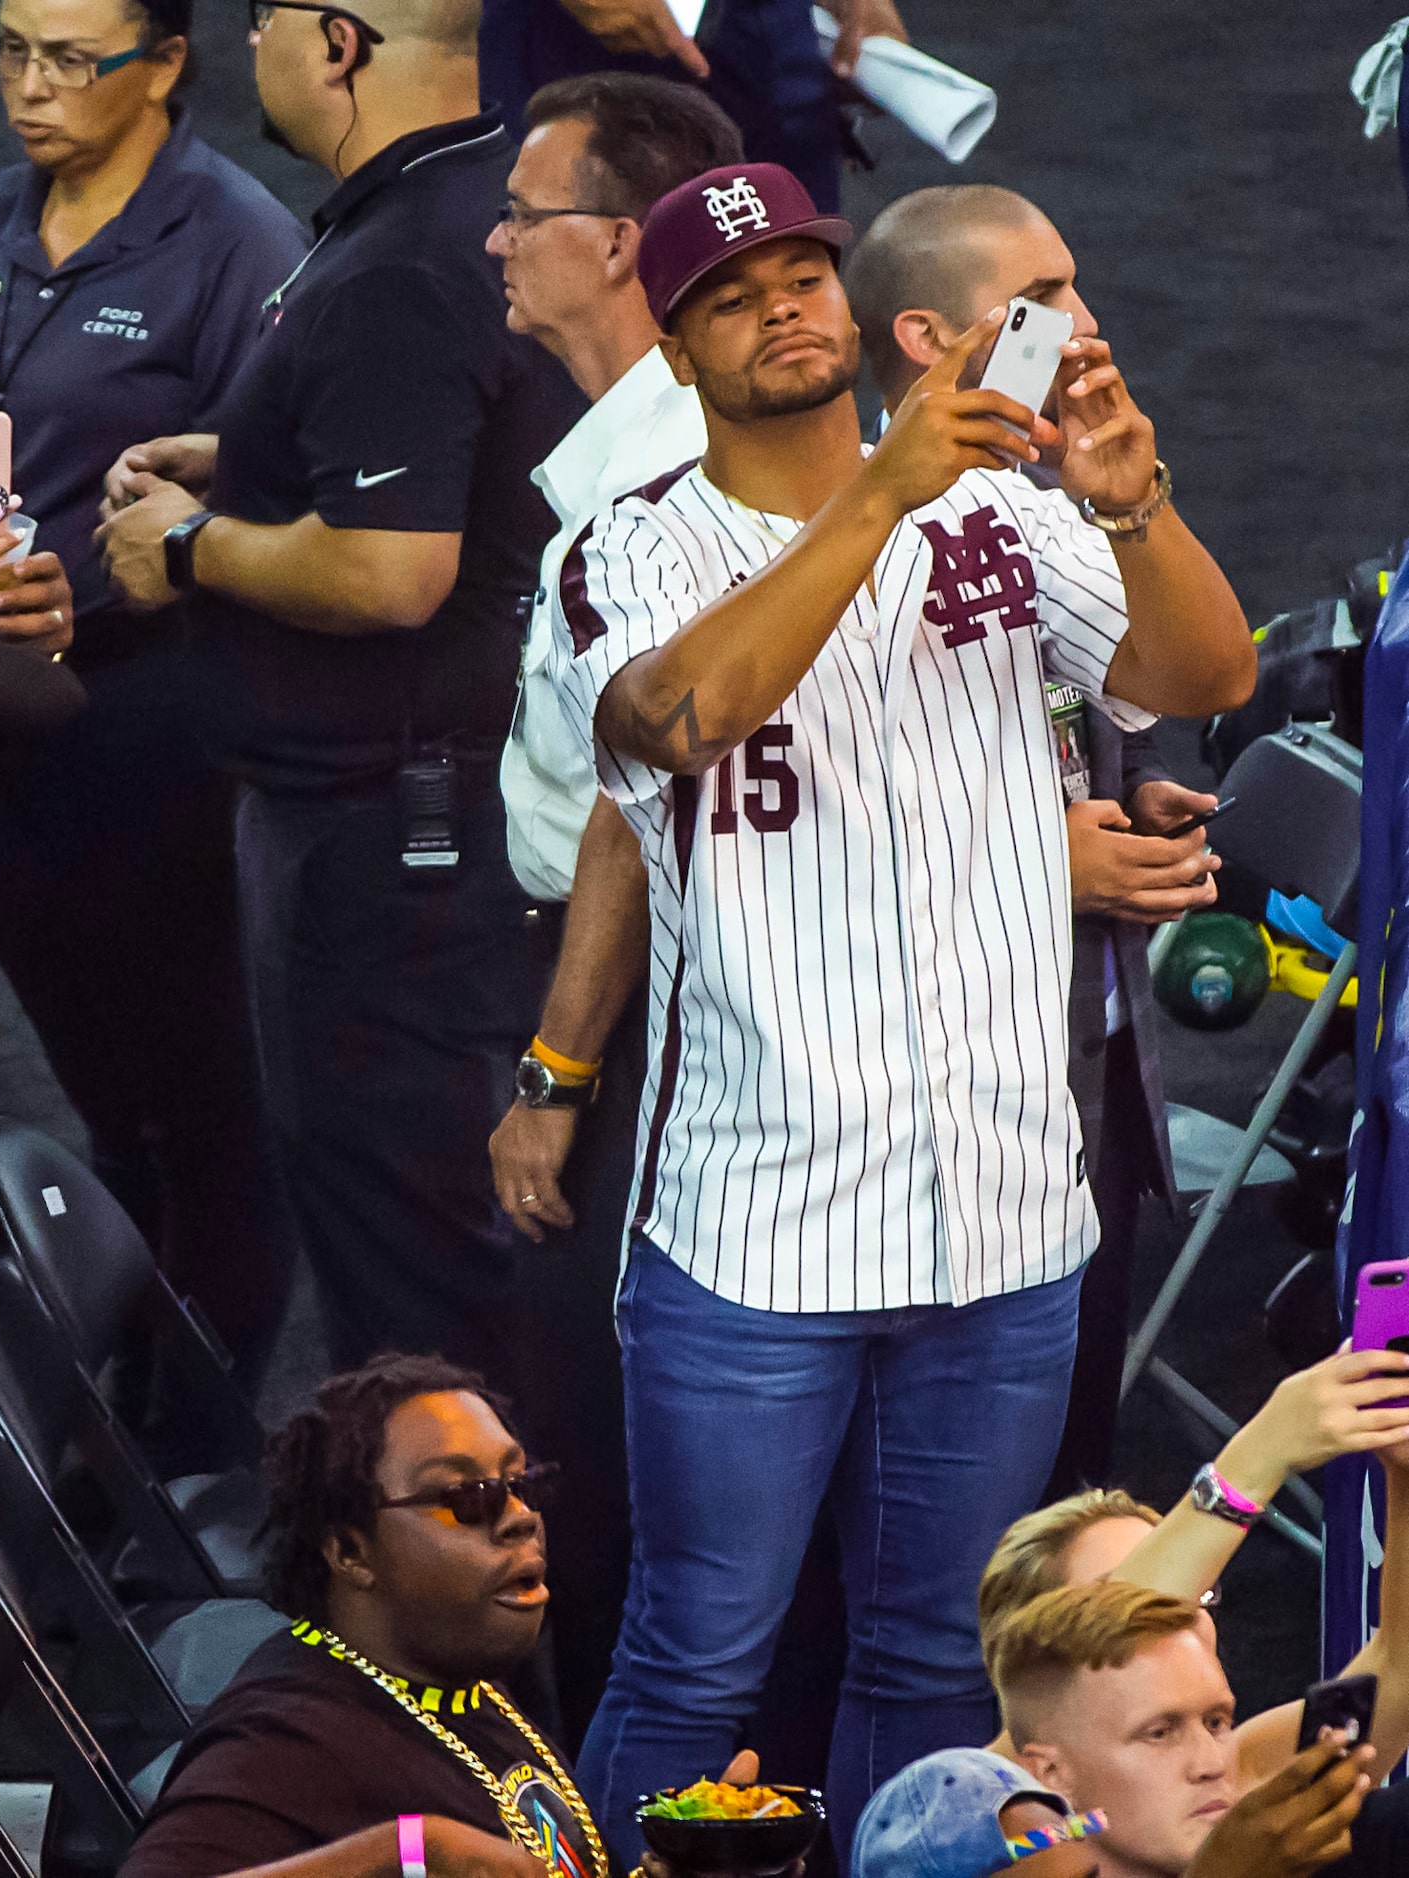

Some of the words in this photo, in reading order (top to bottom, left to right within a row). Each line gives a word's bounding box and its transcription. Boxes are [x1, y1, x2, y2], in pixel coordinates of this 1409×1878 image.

[98, 307, 144, 323] FORD
[82, 320, 149, 341] CENTER
[711, 723, 800, 835] 15
